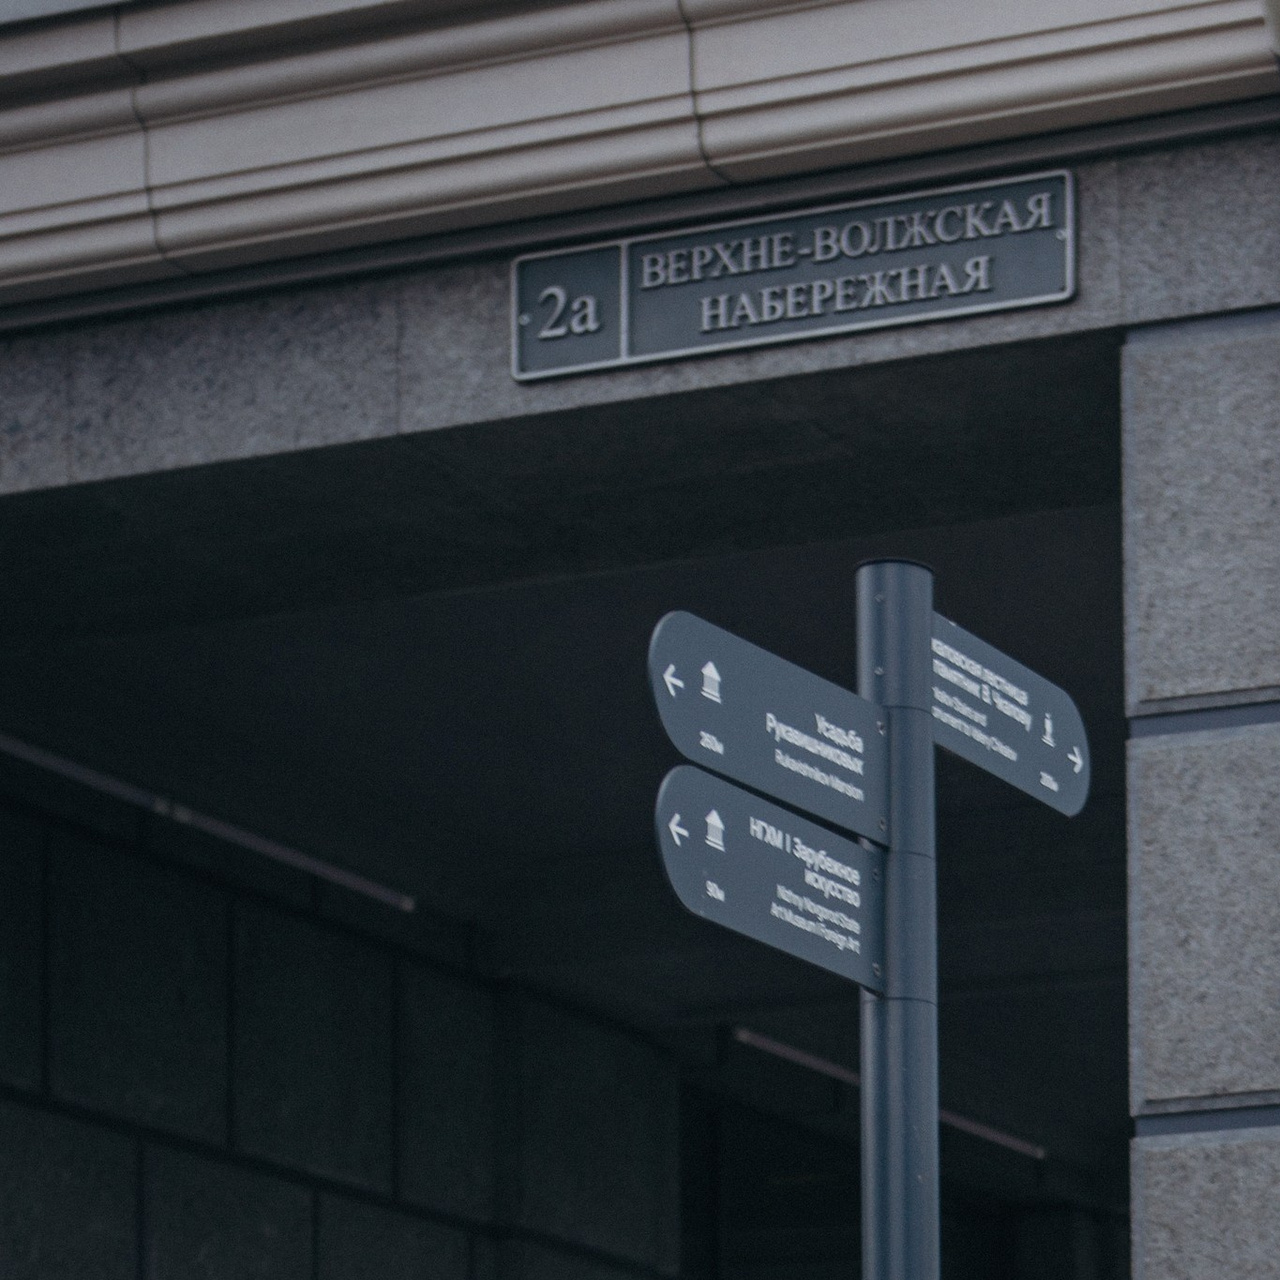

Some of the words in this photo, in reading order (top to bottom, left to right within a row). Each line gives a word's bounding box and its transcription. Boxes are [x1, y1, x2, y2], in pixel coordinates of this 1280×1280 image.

[640, 191, 1053, 290] ВЕРХНЕ-ВОЛЖСКАЯ
[536, 285, 600, 340] 2а
[700, 254, 994, 332] НАБЕРЕЖНАЯ
